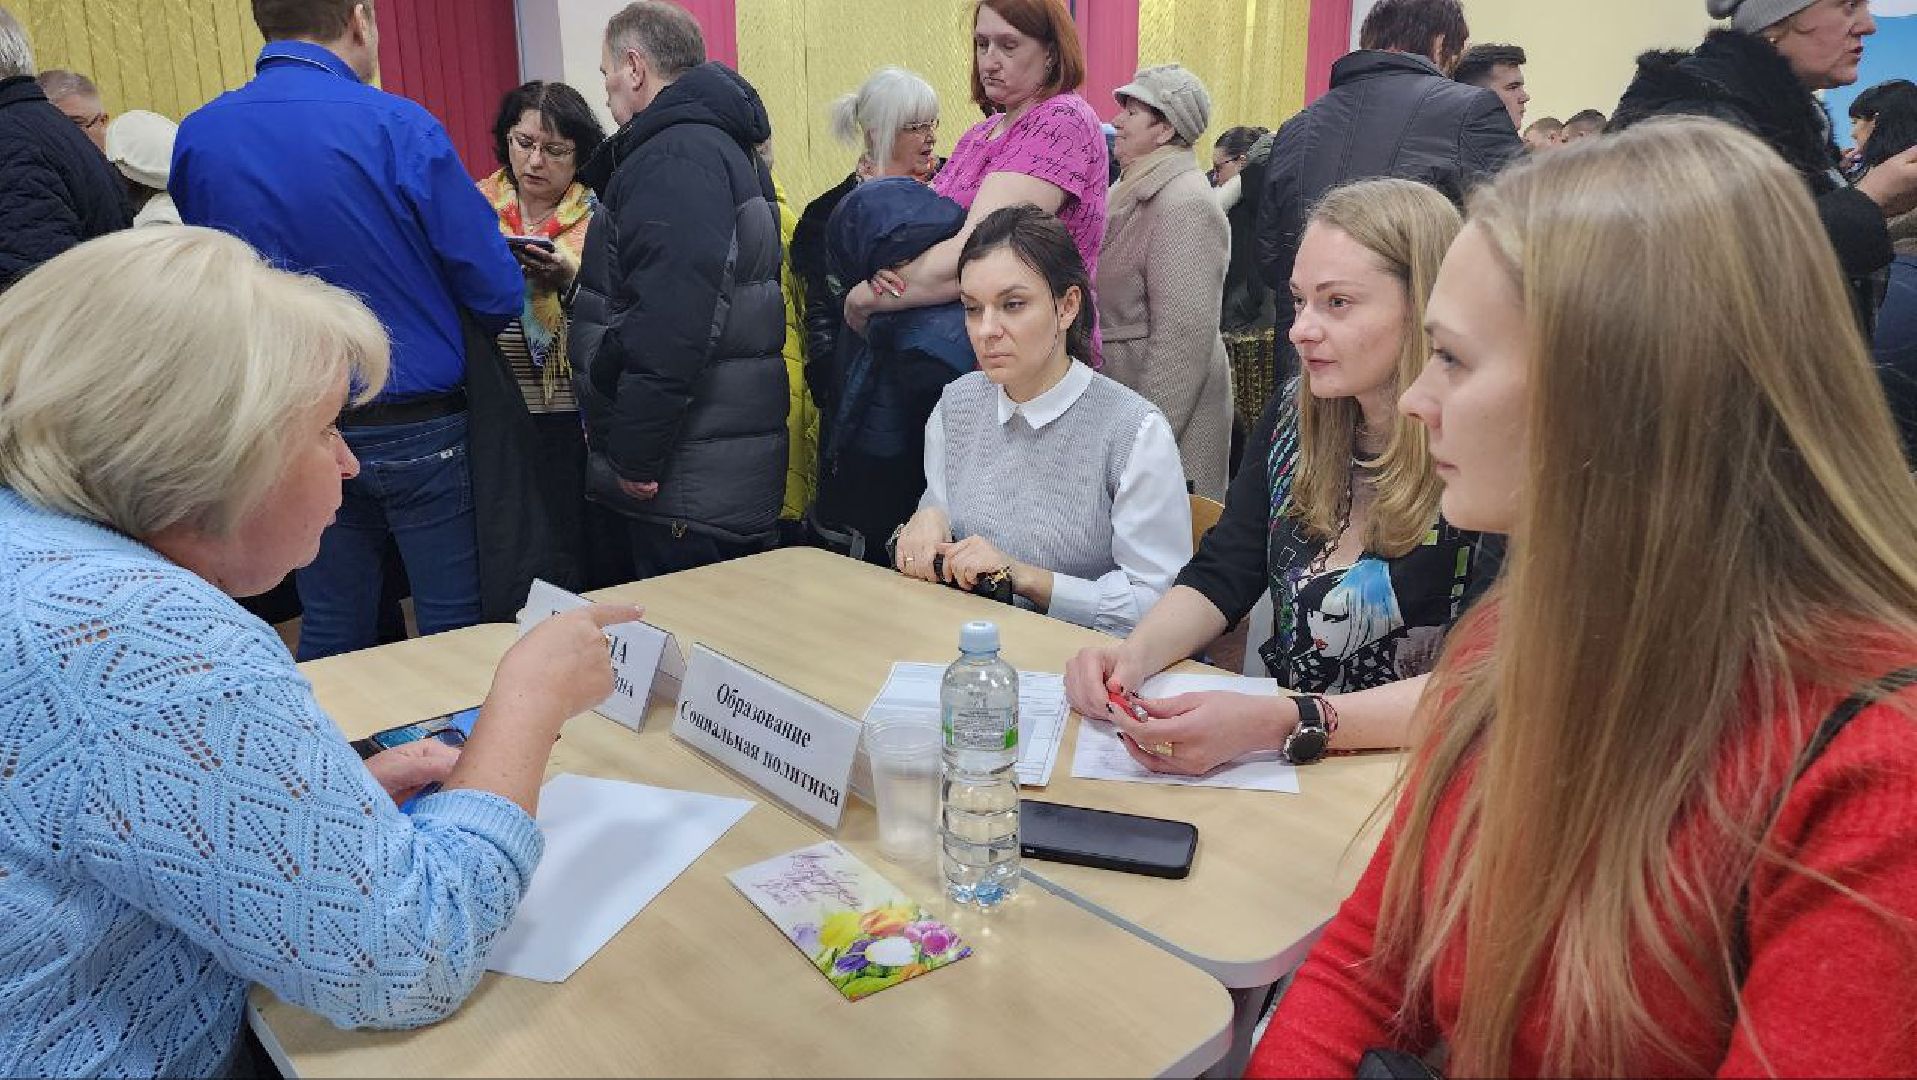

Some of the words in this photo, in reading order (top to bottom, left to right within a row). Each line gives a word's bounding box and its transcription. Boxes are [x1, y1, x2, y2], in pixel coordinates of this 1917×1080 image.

[680, 699, 760, 761] Социальная
[762, 750, 840, 807] политика
[716, 683, 811, 748] Образование
